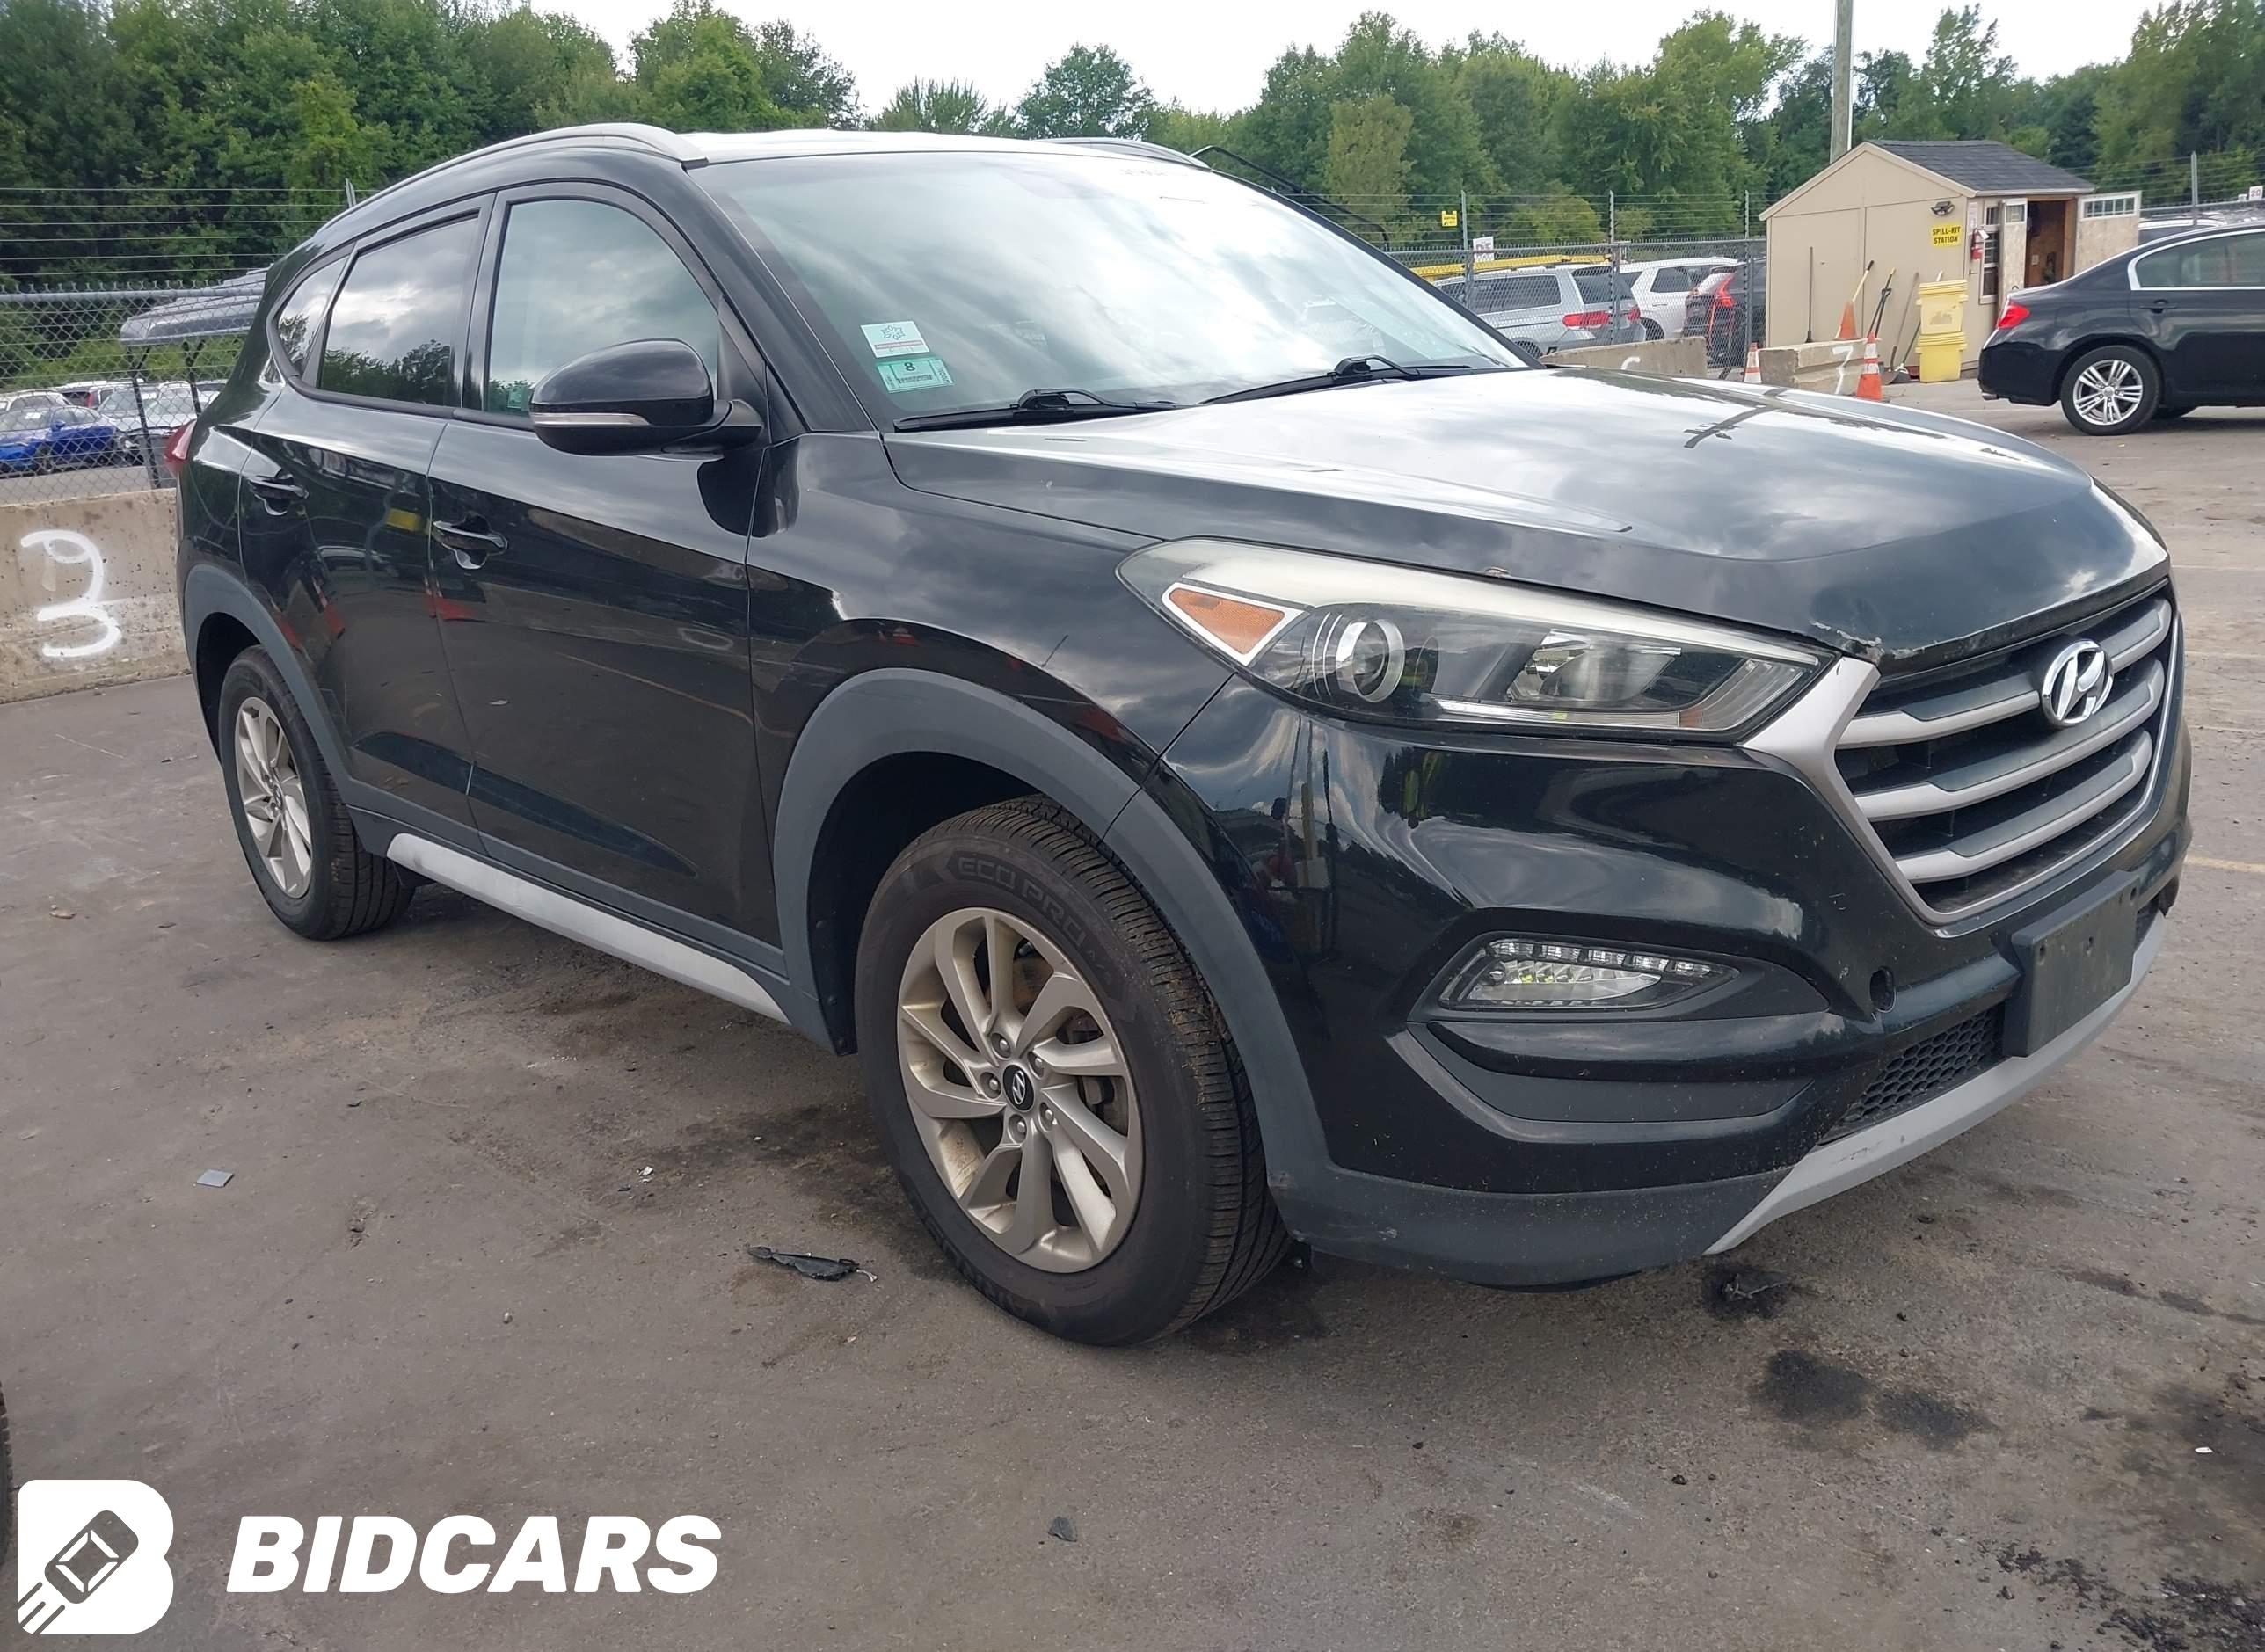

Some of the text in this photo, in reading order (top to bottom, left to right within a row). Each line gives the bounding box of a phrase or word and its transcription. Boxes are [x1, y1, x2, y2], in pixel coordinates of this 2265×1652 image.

[1933, 226, 1961, 236] SPILL-KIT
[1934, 236, 1958, 244] STATION
[904, 361, 916, 372] 8
[958, 856, 1016, 889] ECO
[1022, 880, 1087, 947] PRO
